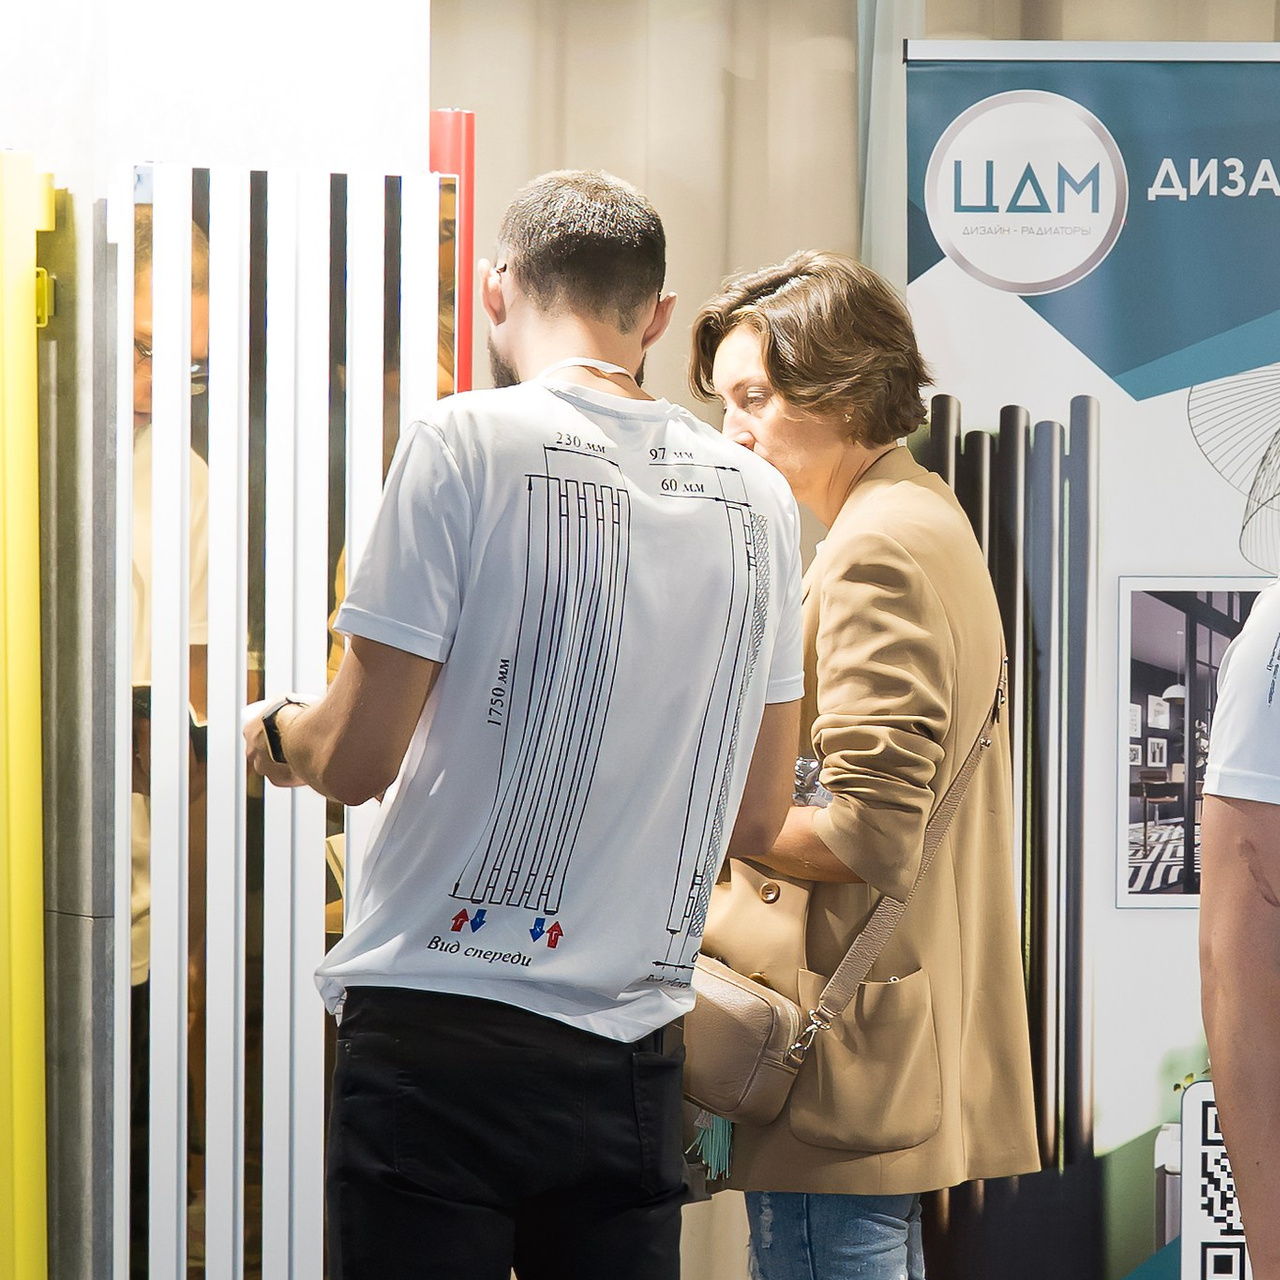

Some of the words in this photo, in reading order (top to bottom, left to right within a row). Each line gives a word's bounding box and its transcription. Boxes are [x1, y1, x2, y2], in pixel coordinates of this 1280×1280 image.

[556, 432, 581, 447] 230
[649, 447, 667, 460] 97
[661, 478, 678, 492] 60
[487, 687, 506, 726] 1750
[427, 935, 460, 954] Вид
[464, 946, 532, 967] спереди
